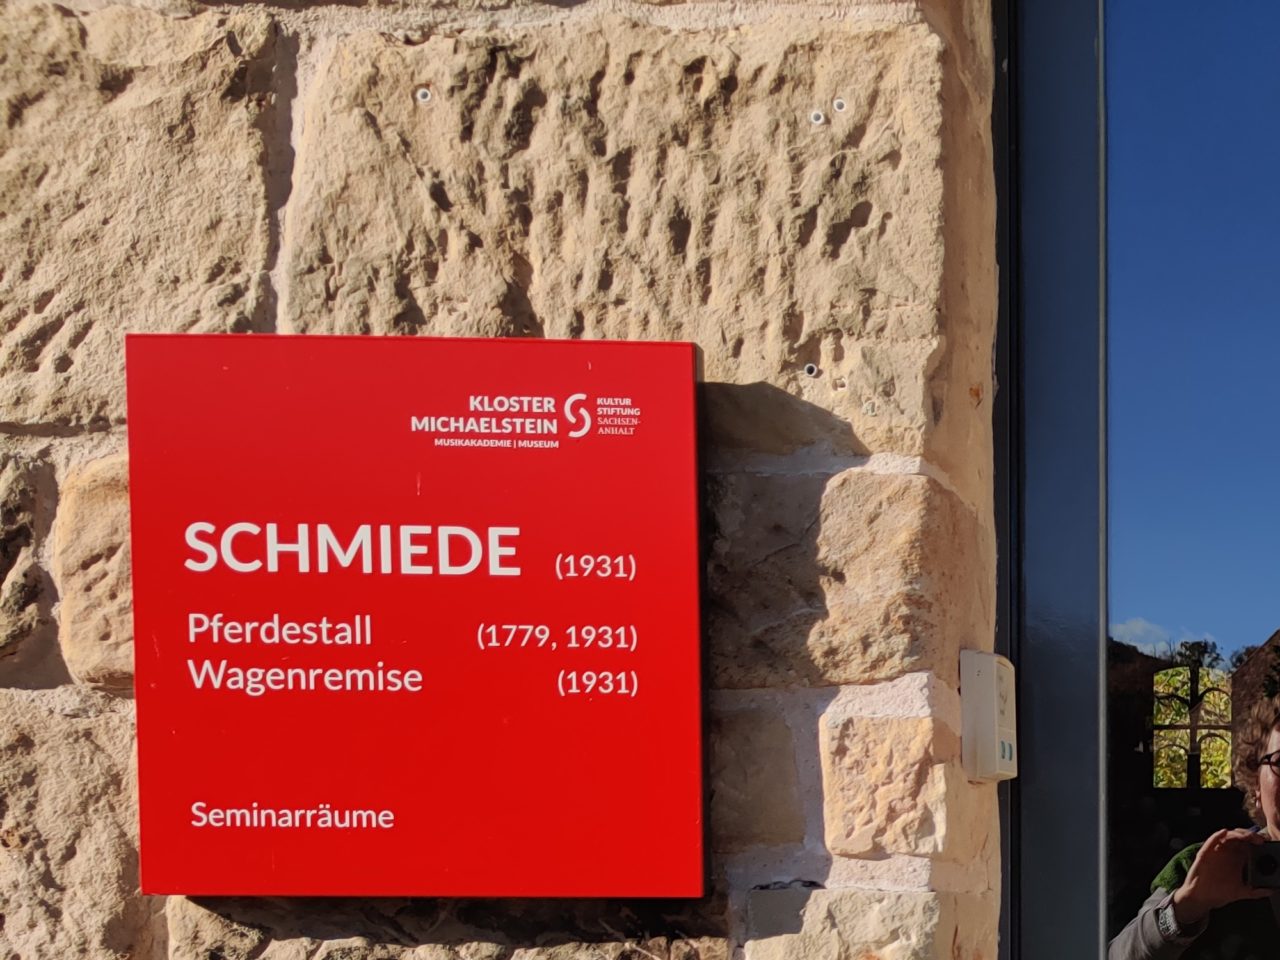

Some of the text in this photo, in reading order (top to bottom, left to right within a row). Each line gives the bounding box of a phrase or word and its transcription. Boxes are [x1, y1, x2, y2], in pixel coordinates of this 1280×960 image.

[469, 395, 556, 413] KLOSTER
[596, 397, 632, 406] KULTUR
[596, 407, 641, 416] STIFTUNG
[411, 416, 558, 434] MICHAELSTEIN
[597, 417, 641, 425] SACHSEN-
[597, 427, 635, 435] ANHALT
[434, 438, 512, 448] MUSIKAKADEMIE
[518, 440, 559, 448] MUSEUM
[184, 522, 637, 581] SCHMIEDE (1931)
[188, 613, 638, 651] Pferdestall (1779, 1931)
[187, 659, 639, 697] Wagenremise (1931)
[190, 801, 395, 828] Seminarräume
